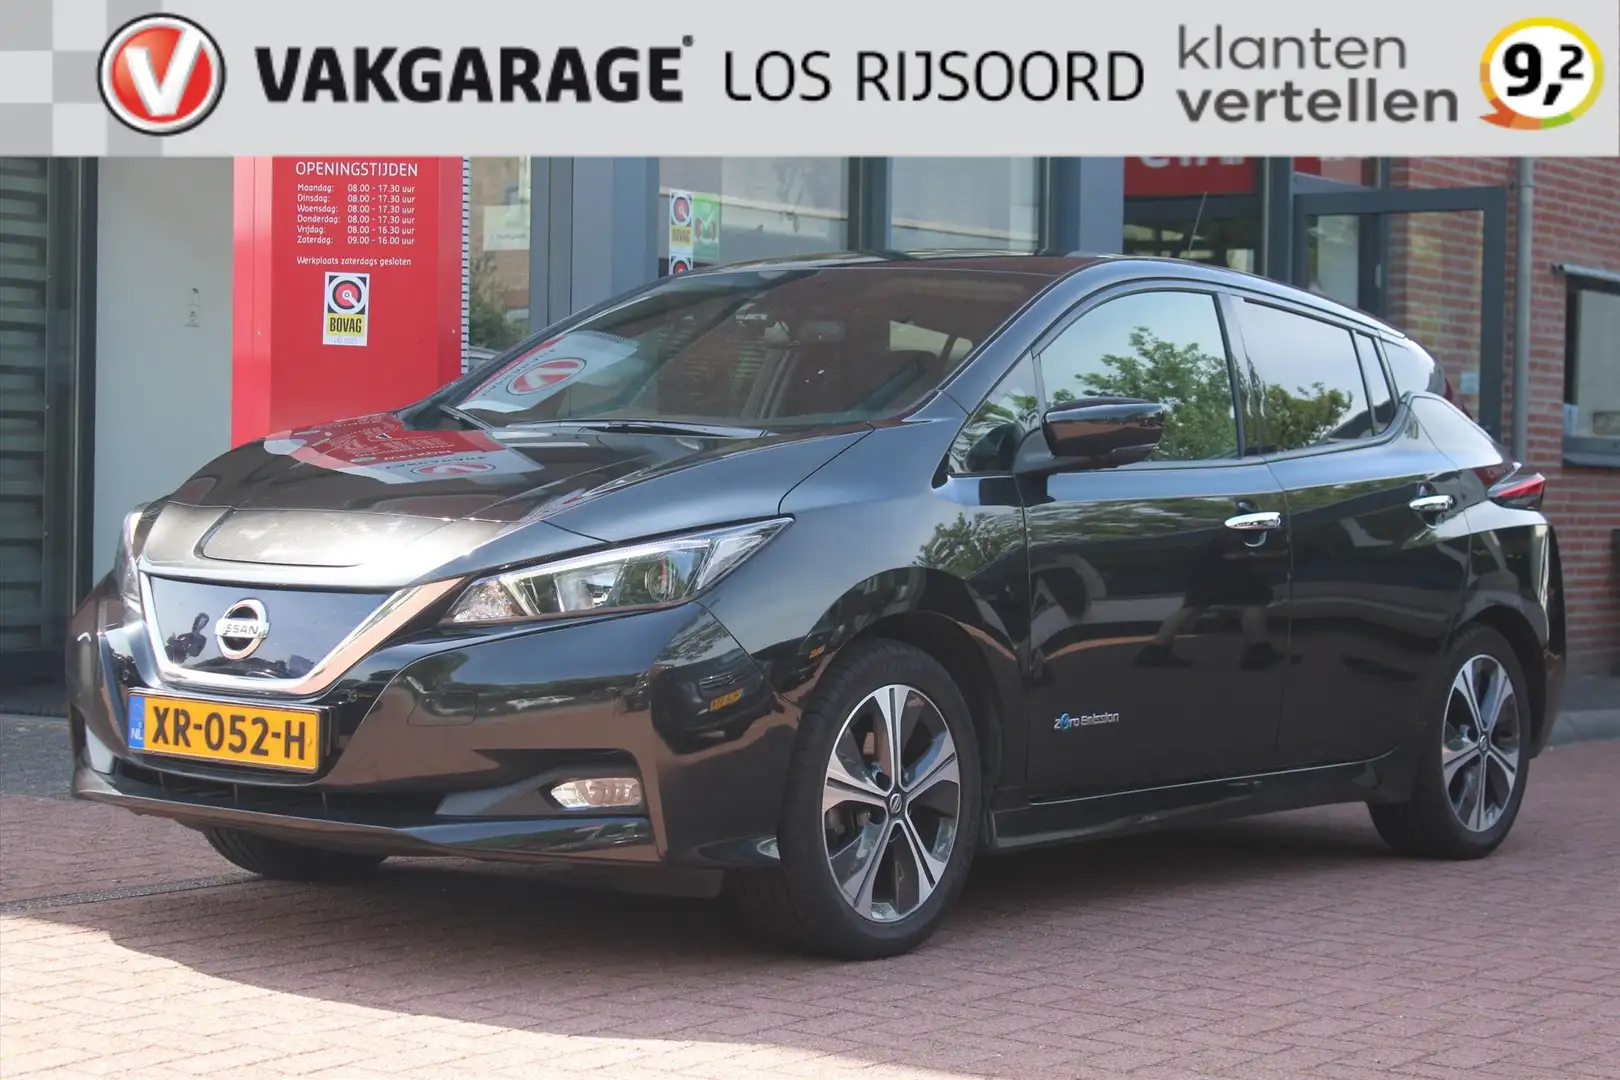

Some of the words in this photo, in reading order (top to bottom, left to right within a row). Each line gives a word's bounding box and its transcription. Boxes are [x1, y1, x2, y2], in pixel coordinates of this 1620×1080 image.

[295, 161, 418, 177] OPENINGSTIJDEN
[298, 184, 334, 193] Maandag:
[348, 184, 369, 192] 08.00
[378, 184, 400, 193] 17.30
[298, 194, 330, 203] Dinsdag:
[348, 194, 369, 202] 08.00
[378, 195, 400, 203] 17.30
[297, 204, 338, 214] Woensdag:
[348, 205, 369, 213] 08.00
[378, 205, 400, 213] 17.30
[298, 215, 340, 224] Donderdag:
[348, 215, 369, 223] 08.00
[378, 216, 400, 224] 17.30
[297, 225, 326, 234] Vrijdag:
[378, 226, 400, 234] 16.30
[297, 236, 333, 245] Zaterdag:
[348, 236, 369, 244] 09.00
[297, 256, 338, 265] Werkplaats
[341, 257, 377, 266] zaterdags
[380, 258, 411, 266] gesloten
[329, 316, 362, 333] BOVAG
[131, 727, 143, 741] NL
[152, 706, 306, 760] XR-052-H
